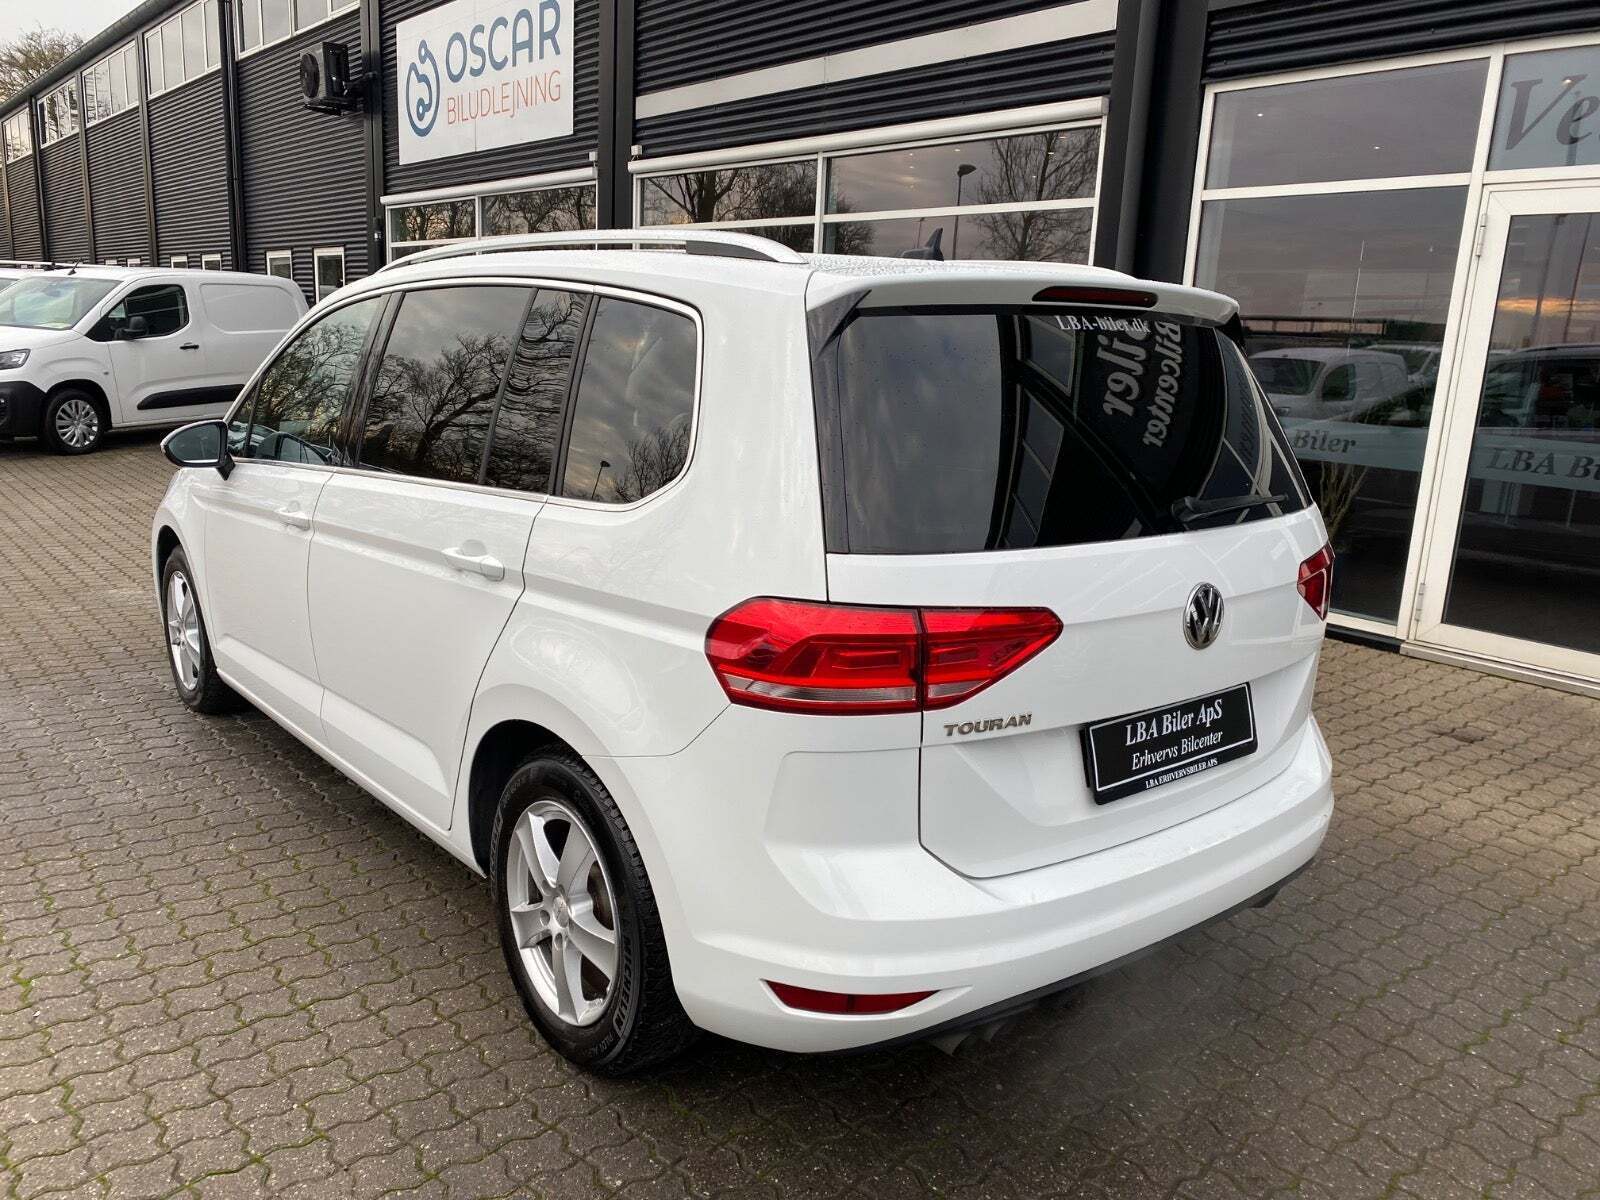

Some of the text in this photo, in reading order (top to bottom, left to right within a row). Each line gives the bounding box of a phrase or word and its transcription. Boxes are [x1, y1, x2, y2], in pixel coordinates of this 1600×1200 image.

[445, 0, 561, 84] OSCAR
[447, 69, 561, 125] BILUDLEJNING
[1055, 314, 1151, 334] LBA-biler.dk
[1293, 429, 1357, 454] Biler
[1486, 447, 1556, 476] LBA
[943, 713, 1033, 737] TOURAN
[1125, 699, 1223, 746] LBA Biler ApS
[1131, 731, 1224, 771] Erhvervs Bilcenter
